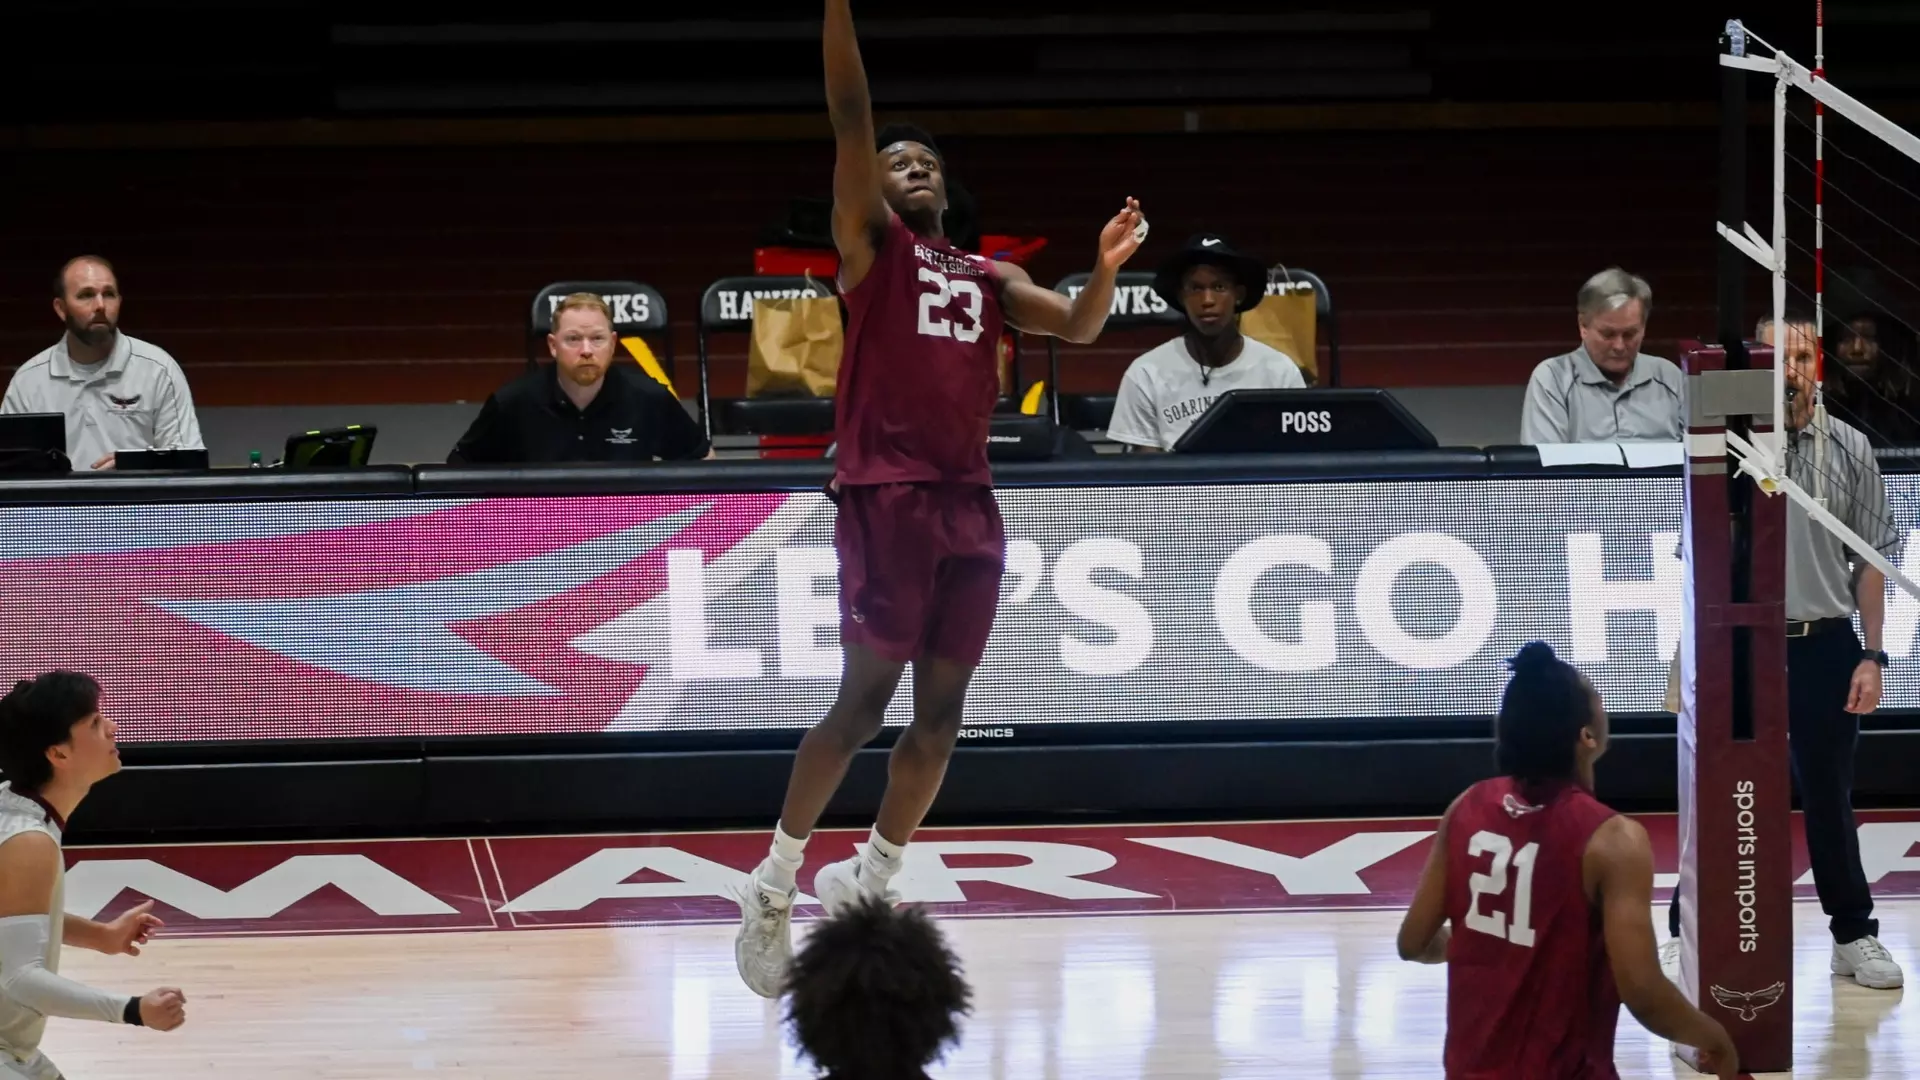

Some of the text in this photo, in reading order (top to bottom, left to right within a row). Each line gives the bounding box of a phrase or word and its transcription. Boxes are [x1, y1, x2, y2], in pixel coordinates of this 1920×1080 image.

[917, 267, 984, 343] 23
[1163, 395, 1221, 424] SOARIN
[1281, 411, 1332, 433] POSS
[666, 537, 1153, 680] LE'S
[1213, 532, 1498, 672] GO
[957, 728, 1014, 738] RONICS
[1465, 830, 1540, 948] 21
[1732, 780, 1760, 953] sports imports
